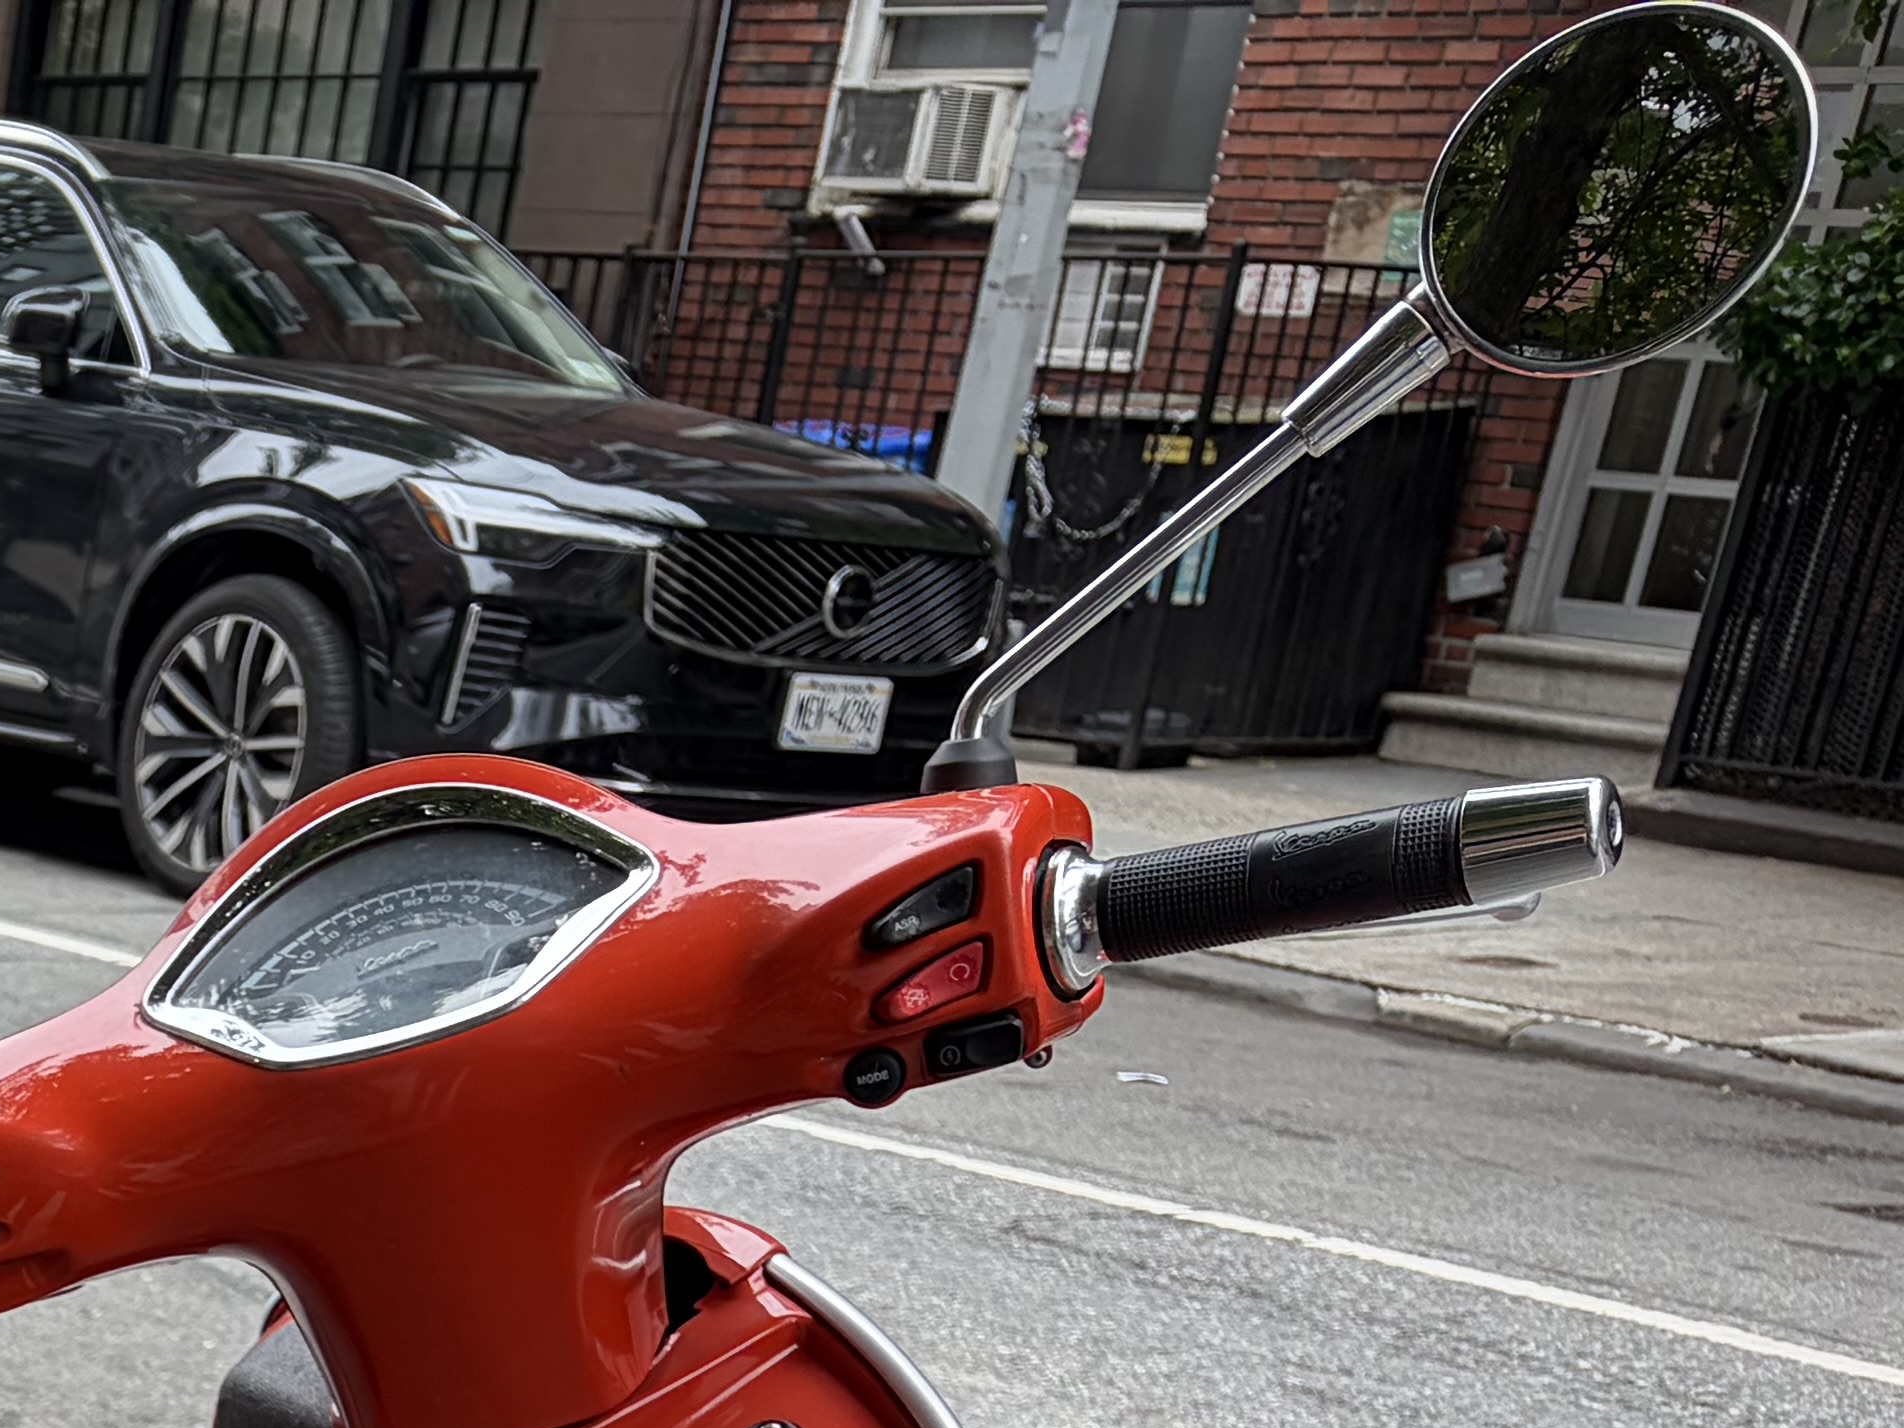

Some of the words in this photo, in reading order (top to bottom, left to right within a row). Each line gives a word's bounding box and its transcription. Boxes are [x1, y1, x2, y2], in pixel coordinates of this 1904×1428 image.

[1272, 818, 1376, 861] Vespa
[484, 898, 509, 914] 80
[504, 908, 526, 928] 90
[856, 1069, 890, 1086] MODE
